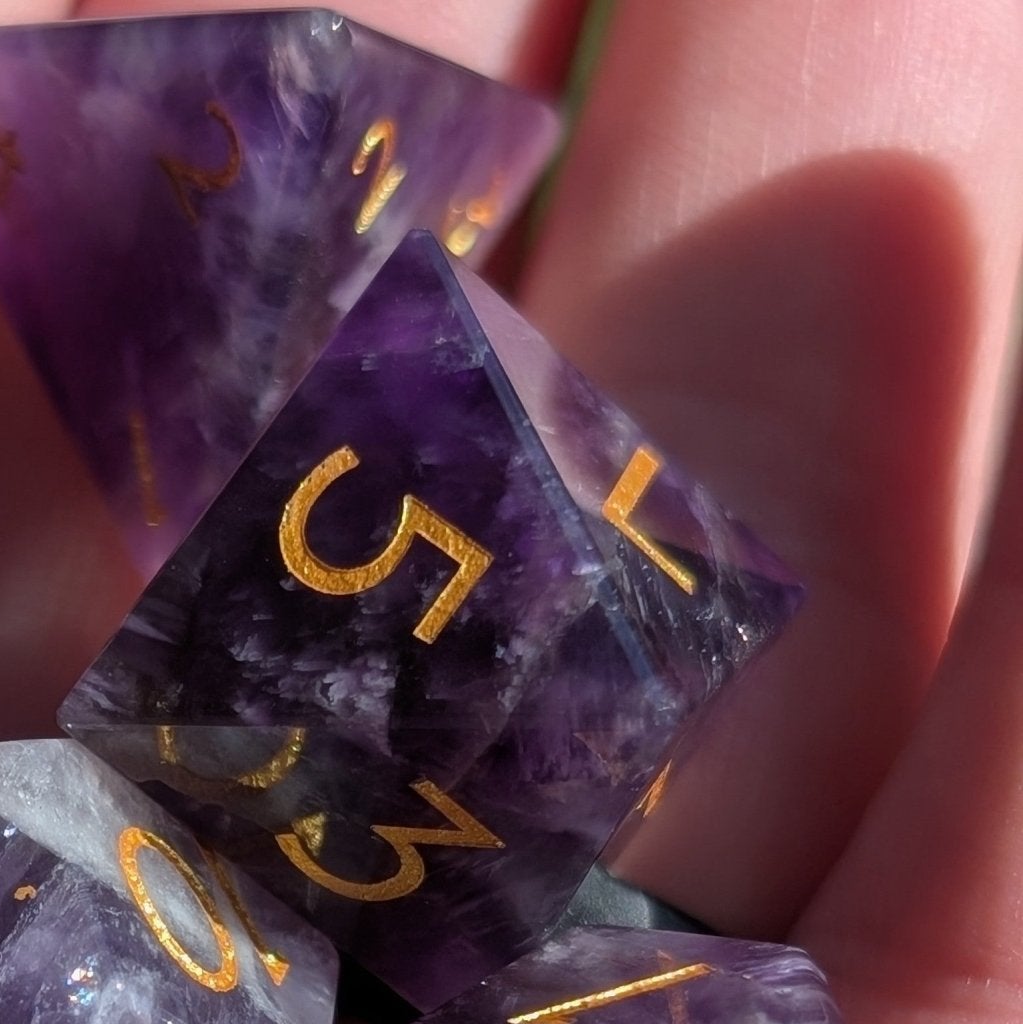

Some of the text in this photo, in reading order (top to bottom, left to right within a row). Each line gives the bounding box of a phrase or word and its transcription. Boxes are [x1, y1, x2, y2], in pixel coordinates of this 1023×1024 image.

[351, 119, 408, 234] 2
[278, 444, 495, 644] 5
[118, 826, 291, 993] 10
[275, 775, 507, 901] 3
